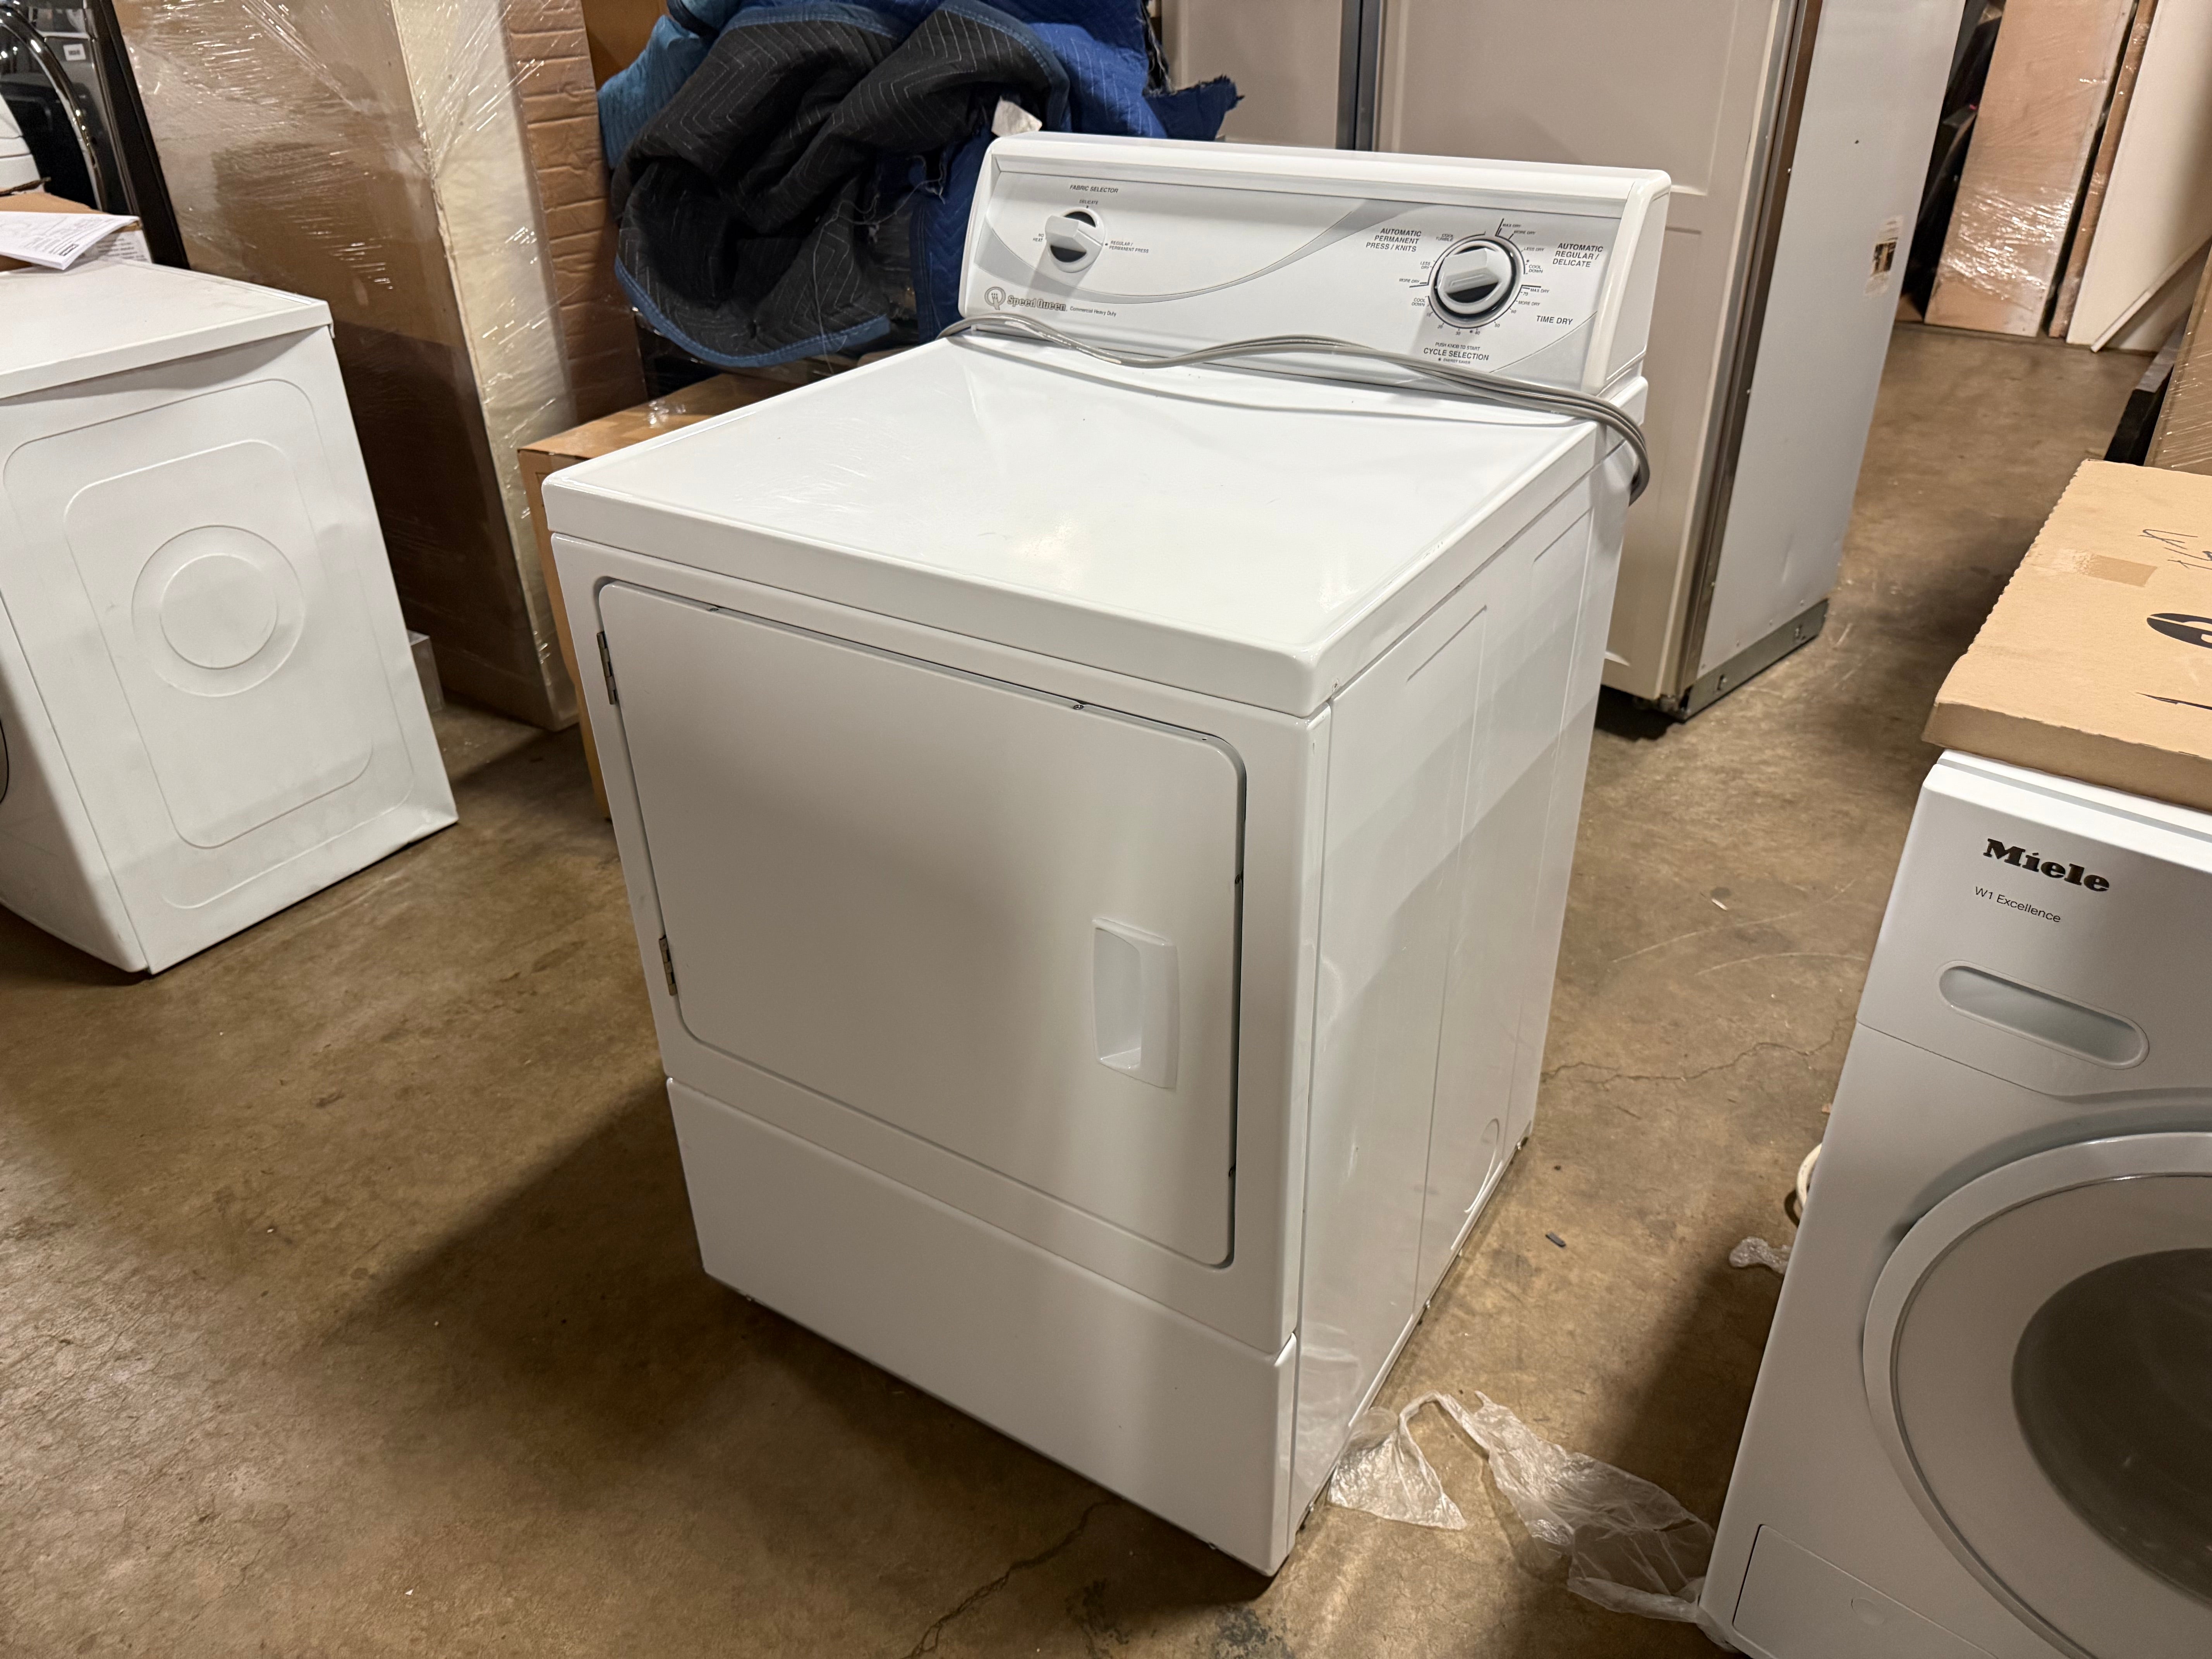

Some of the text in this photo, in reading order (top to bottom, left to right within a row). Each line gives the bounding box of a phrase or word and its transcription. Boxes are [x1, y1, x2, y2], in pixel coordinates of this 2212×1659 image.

[1380, 228, 1422, 237] AUTOMATIC
[1374, 235, 1419, 244] PERMANENT
[1558, 243, 1603, 252] AUTOMATIC
[1553, 258, 1591, 267] DELICATE
[1007, 295, 1037, 307] Speed
[1037, 299, 1066, 311] Queen
[1424, 347, 1489, 361] CYCLE SELECTION
[1982, 838, 2110, 893] Miele
[1975, 885, 2061, 924] W1 Excellence
